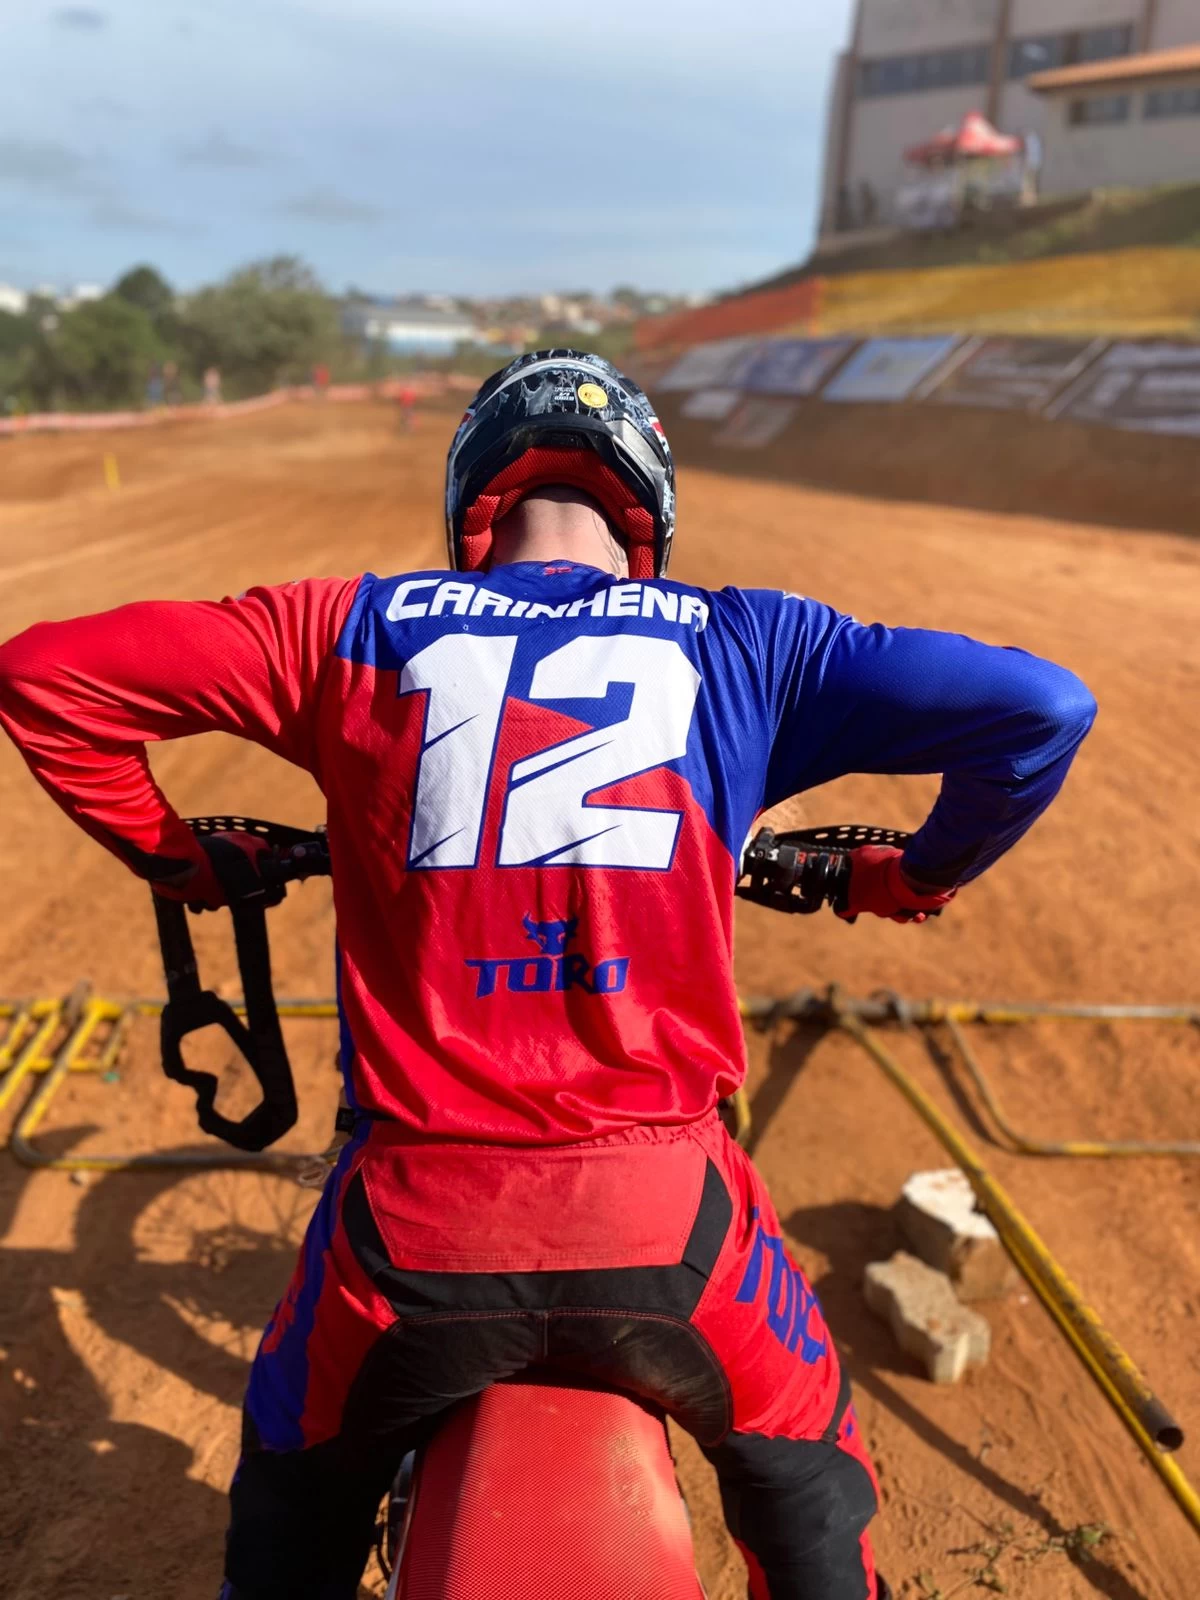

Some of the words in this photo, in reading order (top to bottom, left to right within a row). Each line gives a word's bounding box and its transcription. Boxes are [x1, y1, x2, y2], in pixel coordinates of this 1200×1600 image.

[386, 578, 710, 633] CARINHENA
[400, 633, 702, 871] 12
[464, 953, 631, 999] TORO
[734, 1225, 826, 1366] TOR
